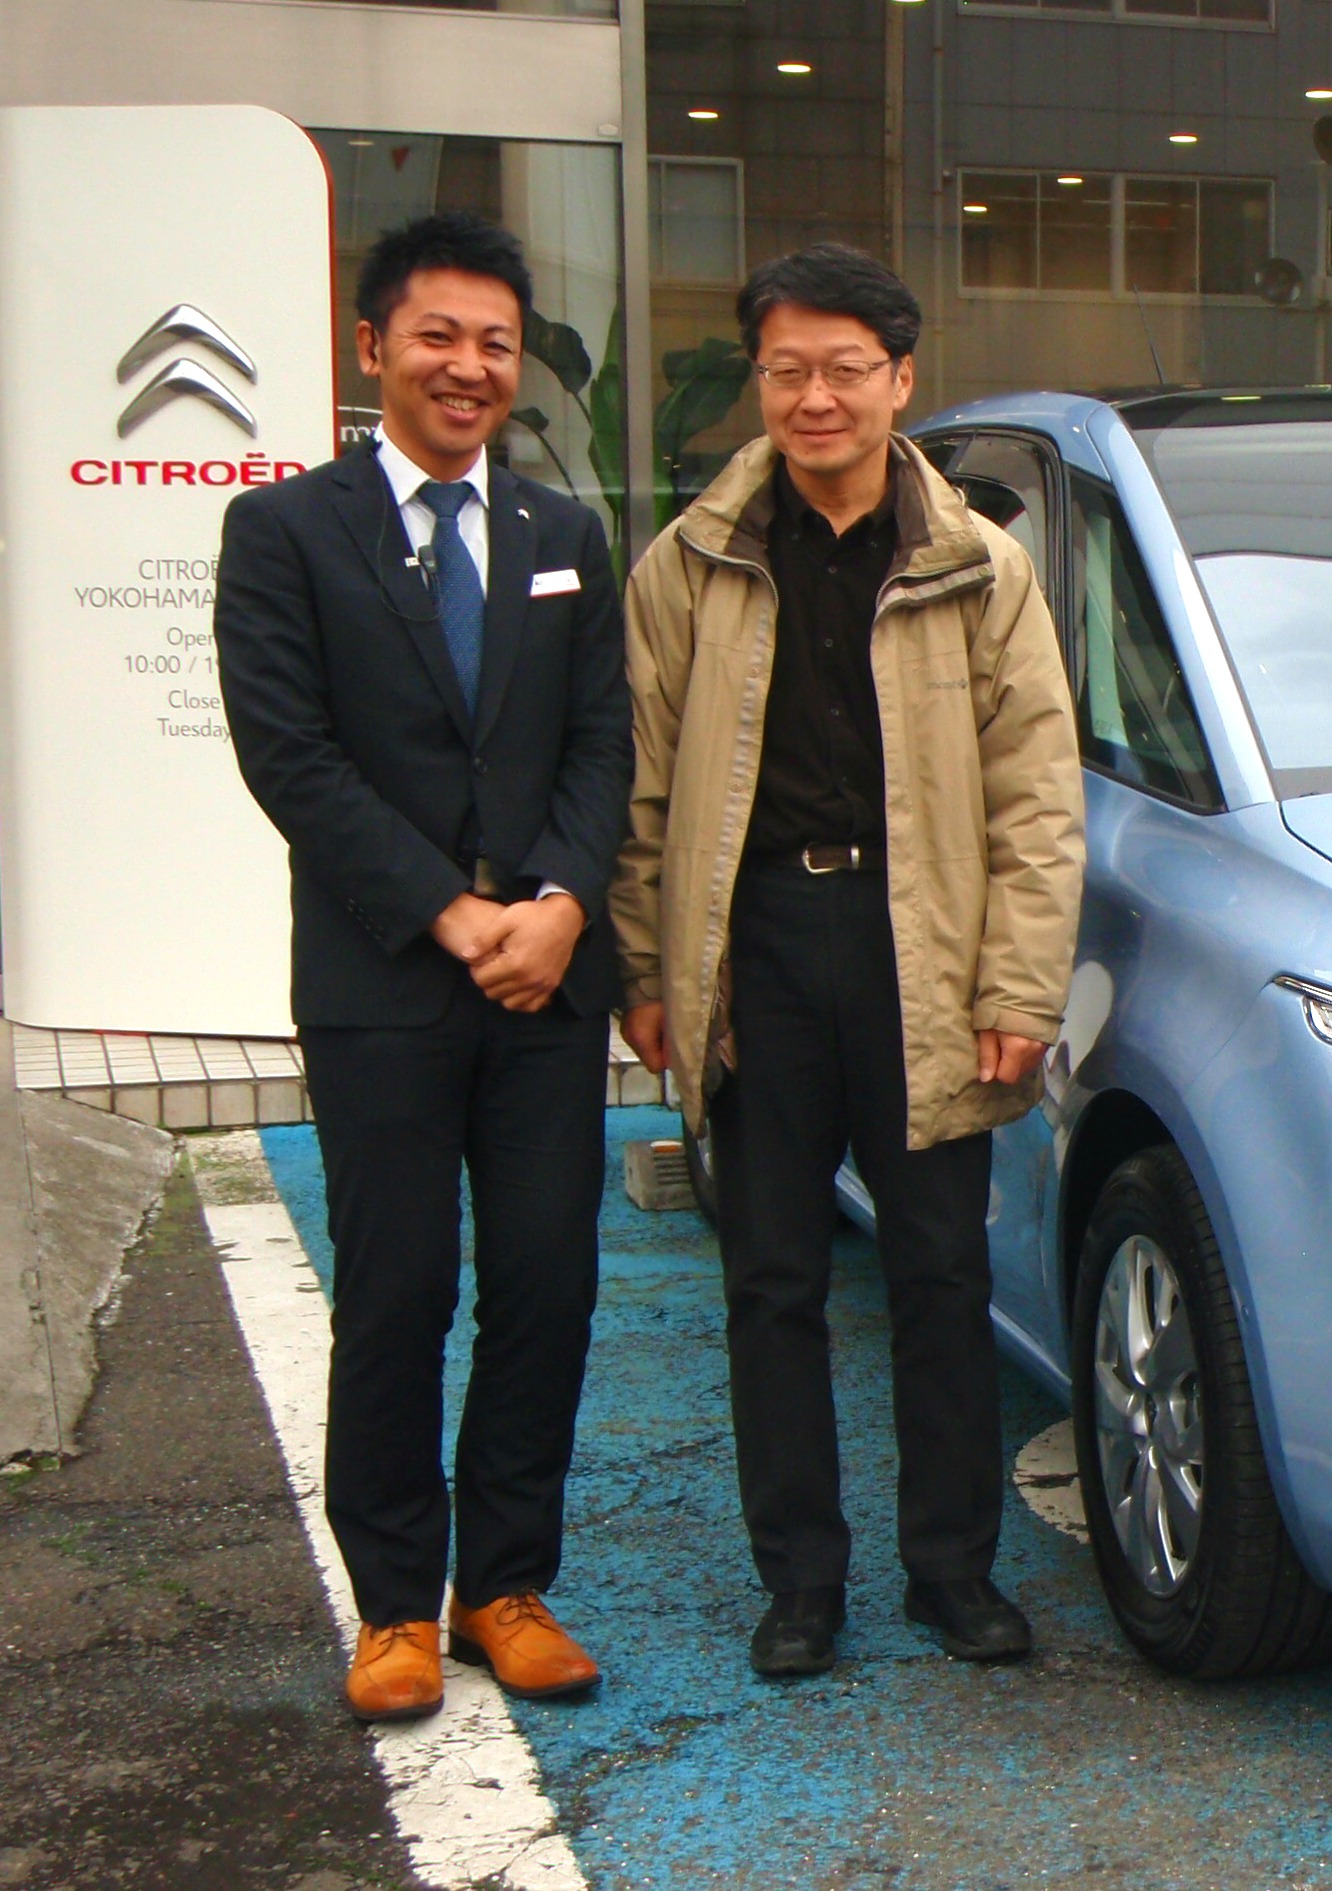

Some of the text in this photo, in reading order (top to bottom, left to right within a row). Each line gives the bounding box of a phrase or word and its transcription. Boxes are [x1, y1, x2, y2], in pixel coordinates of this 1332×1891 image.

[138, 554, 219, 581] CITROË
[74, 587, 215, 608] YOKOHAMA
[124, 654, 181, 674] 10:00
[168, 689, 220, 709] Close
